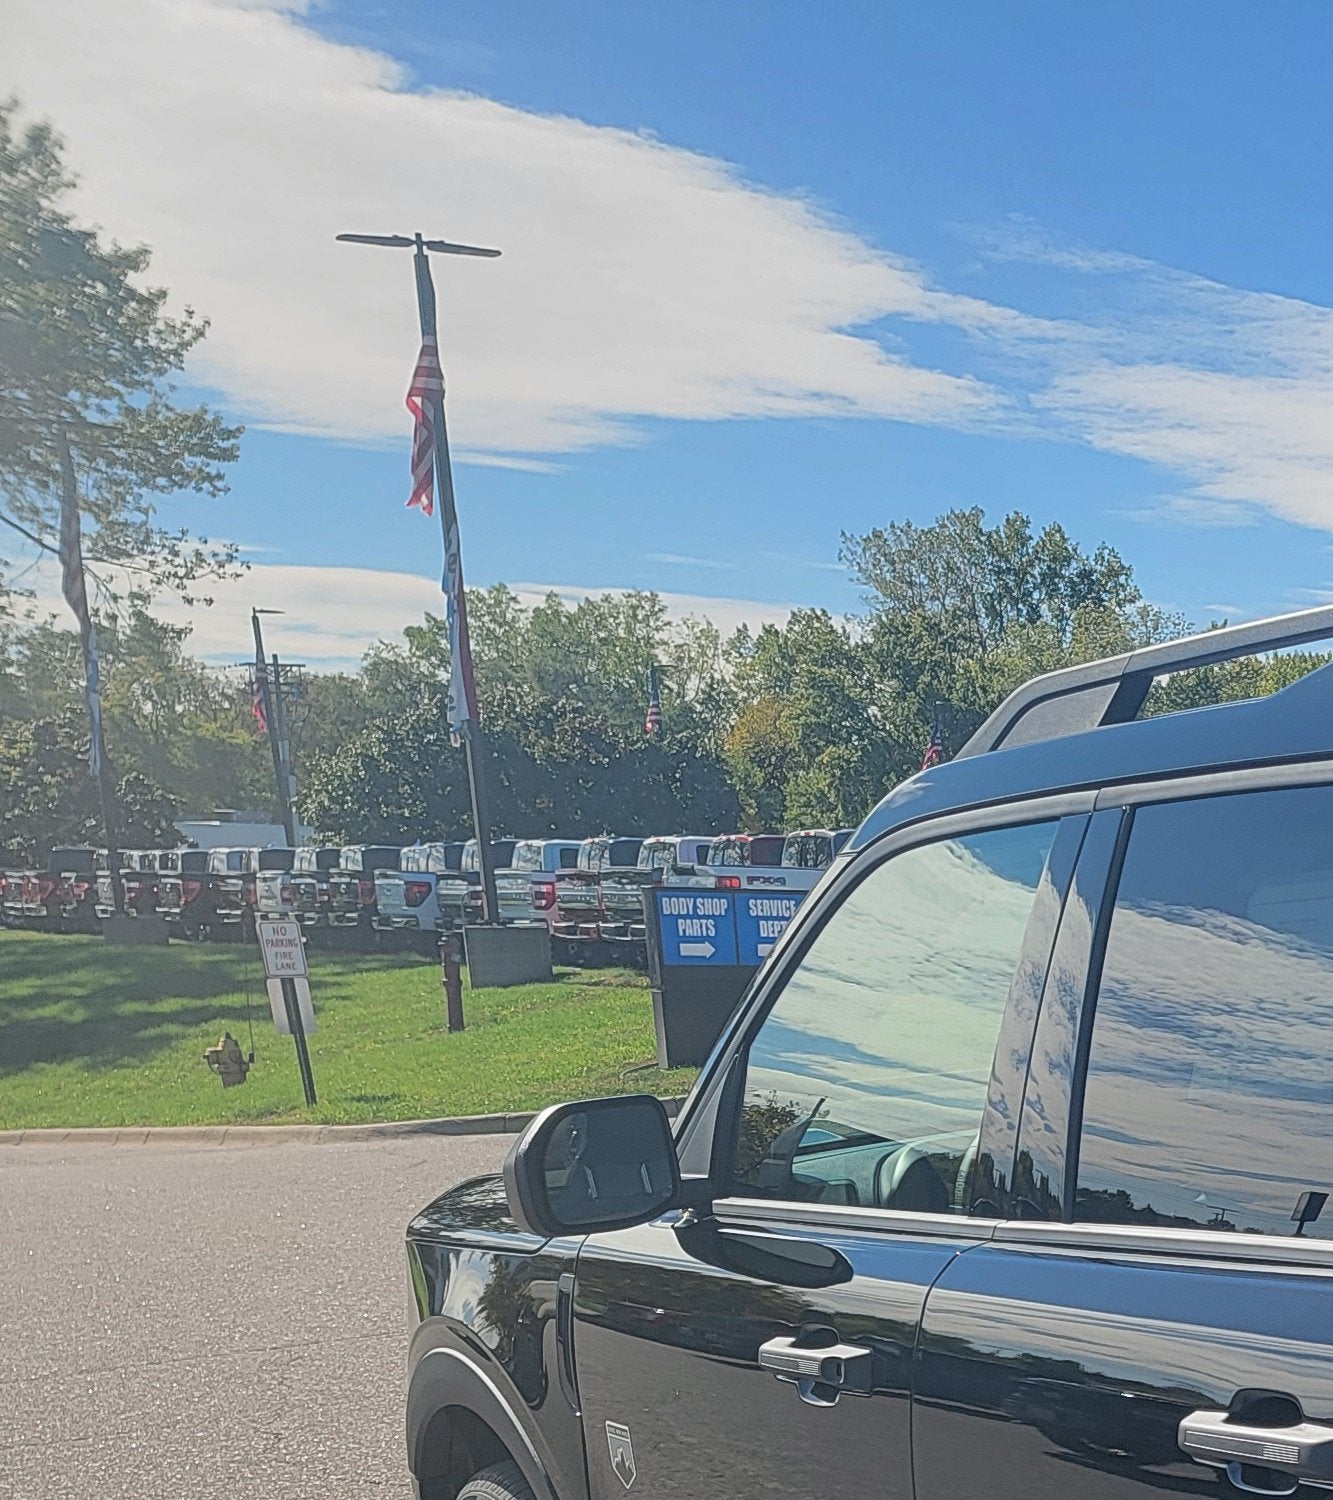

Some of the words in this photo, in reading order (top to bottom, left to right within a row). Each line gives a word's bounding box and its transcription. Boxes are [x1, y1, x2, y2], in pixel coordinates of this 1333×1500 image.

[746, 875, 787, 887] FX4
[661, 896, 695, 916] BODY
[696, 897, 729, 916] SHOP
[272, 925, 287, 937] NO
[677, 918, 716, 938] PARTS
[265, 937, 299, 949] PARKING
[274, 951, 294, 961] FIRE
[275, 961, 297, 971] LANE
